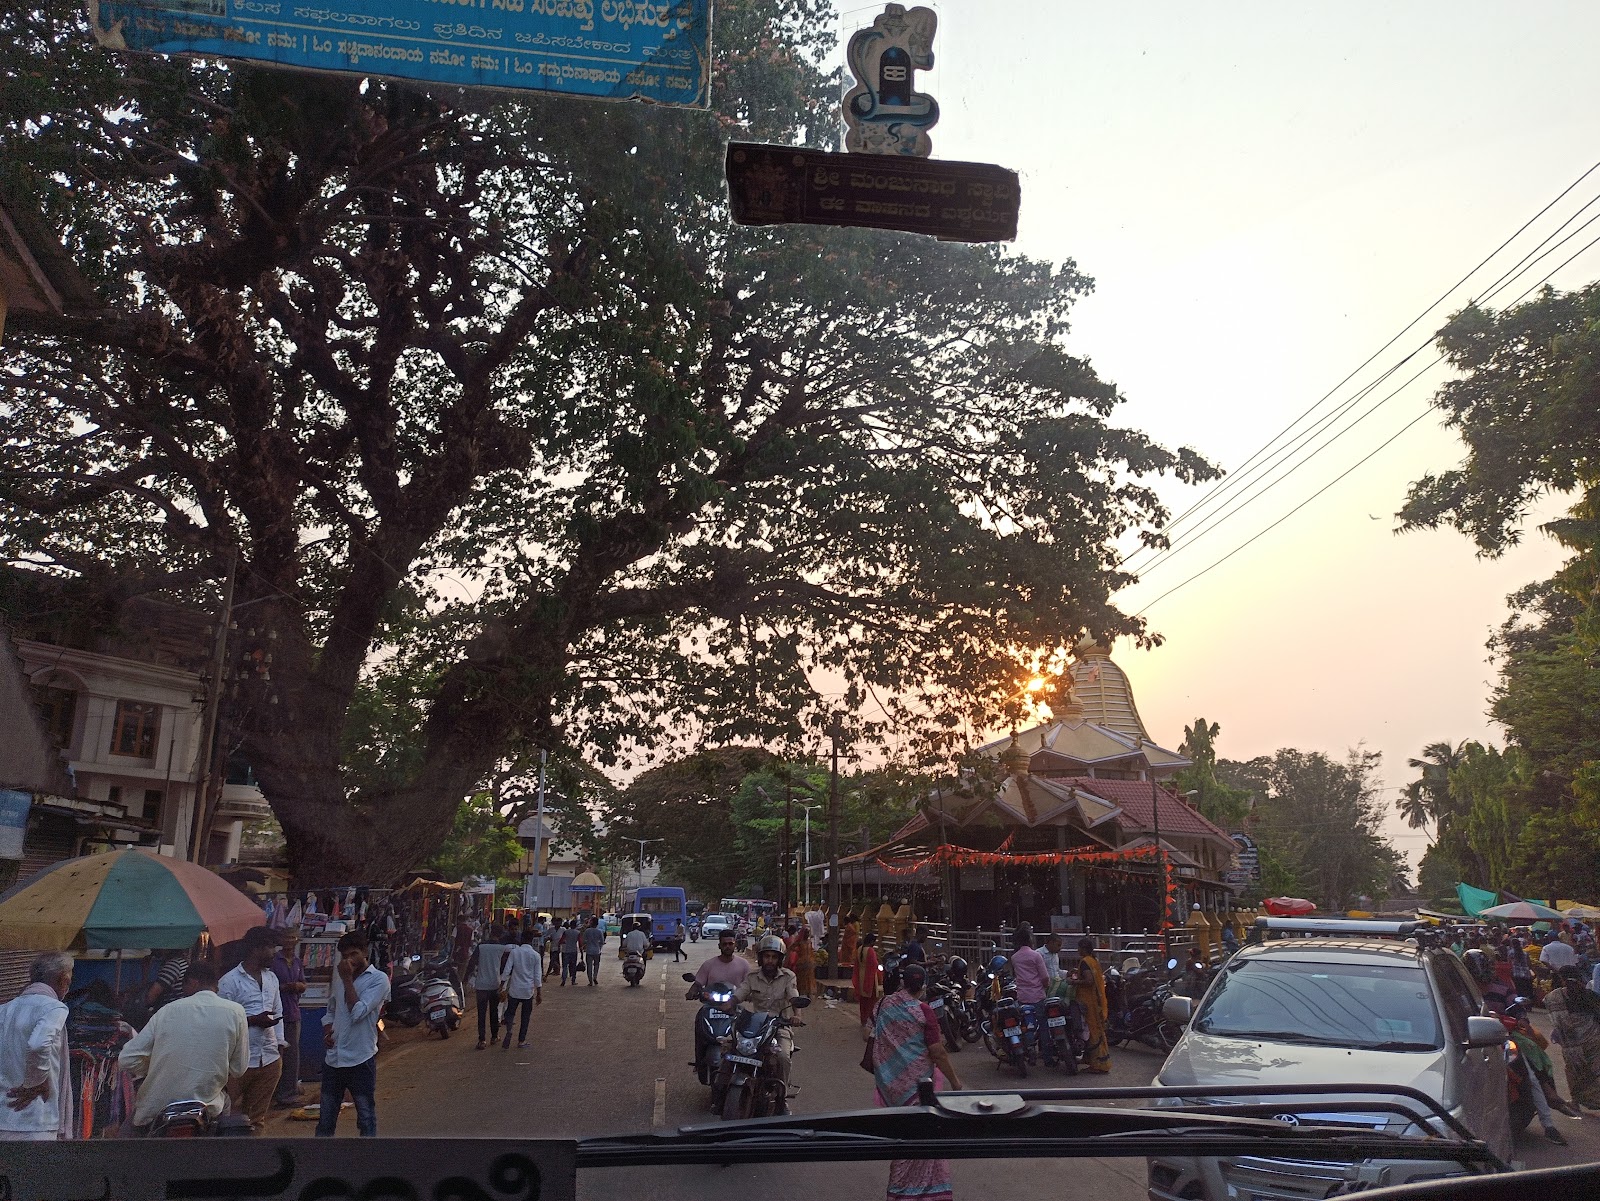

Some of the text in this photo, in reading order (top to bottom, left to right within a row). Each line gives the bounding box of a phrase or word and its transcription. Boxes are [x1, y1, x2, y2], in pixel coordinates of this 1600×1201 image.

[293, 6, 420, 31] ಸಫಲವಾಗಲು
[433, 22, 503, 40] ಪ್ರತಿದಿನ
[515, 31, 631, 53] ಜಪಿಸಬೇಕಾದ
[642, 45, 694, 65] ಮಂತ್ರ
[430, 48, 466, 66] ನಮೋ
[812, 166, 840, 191] ಶ್ರೀ
